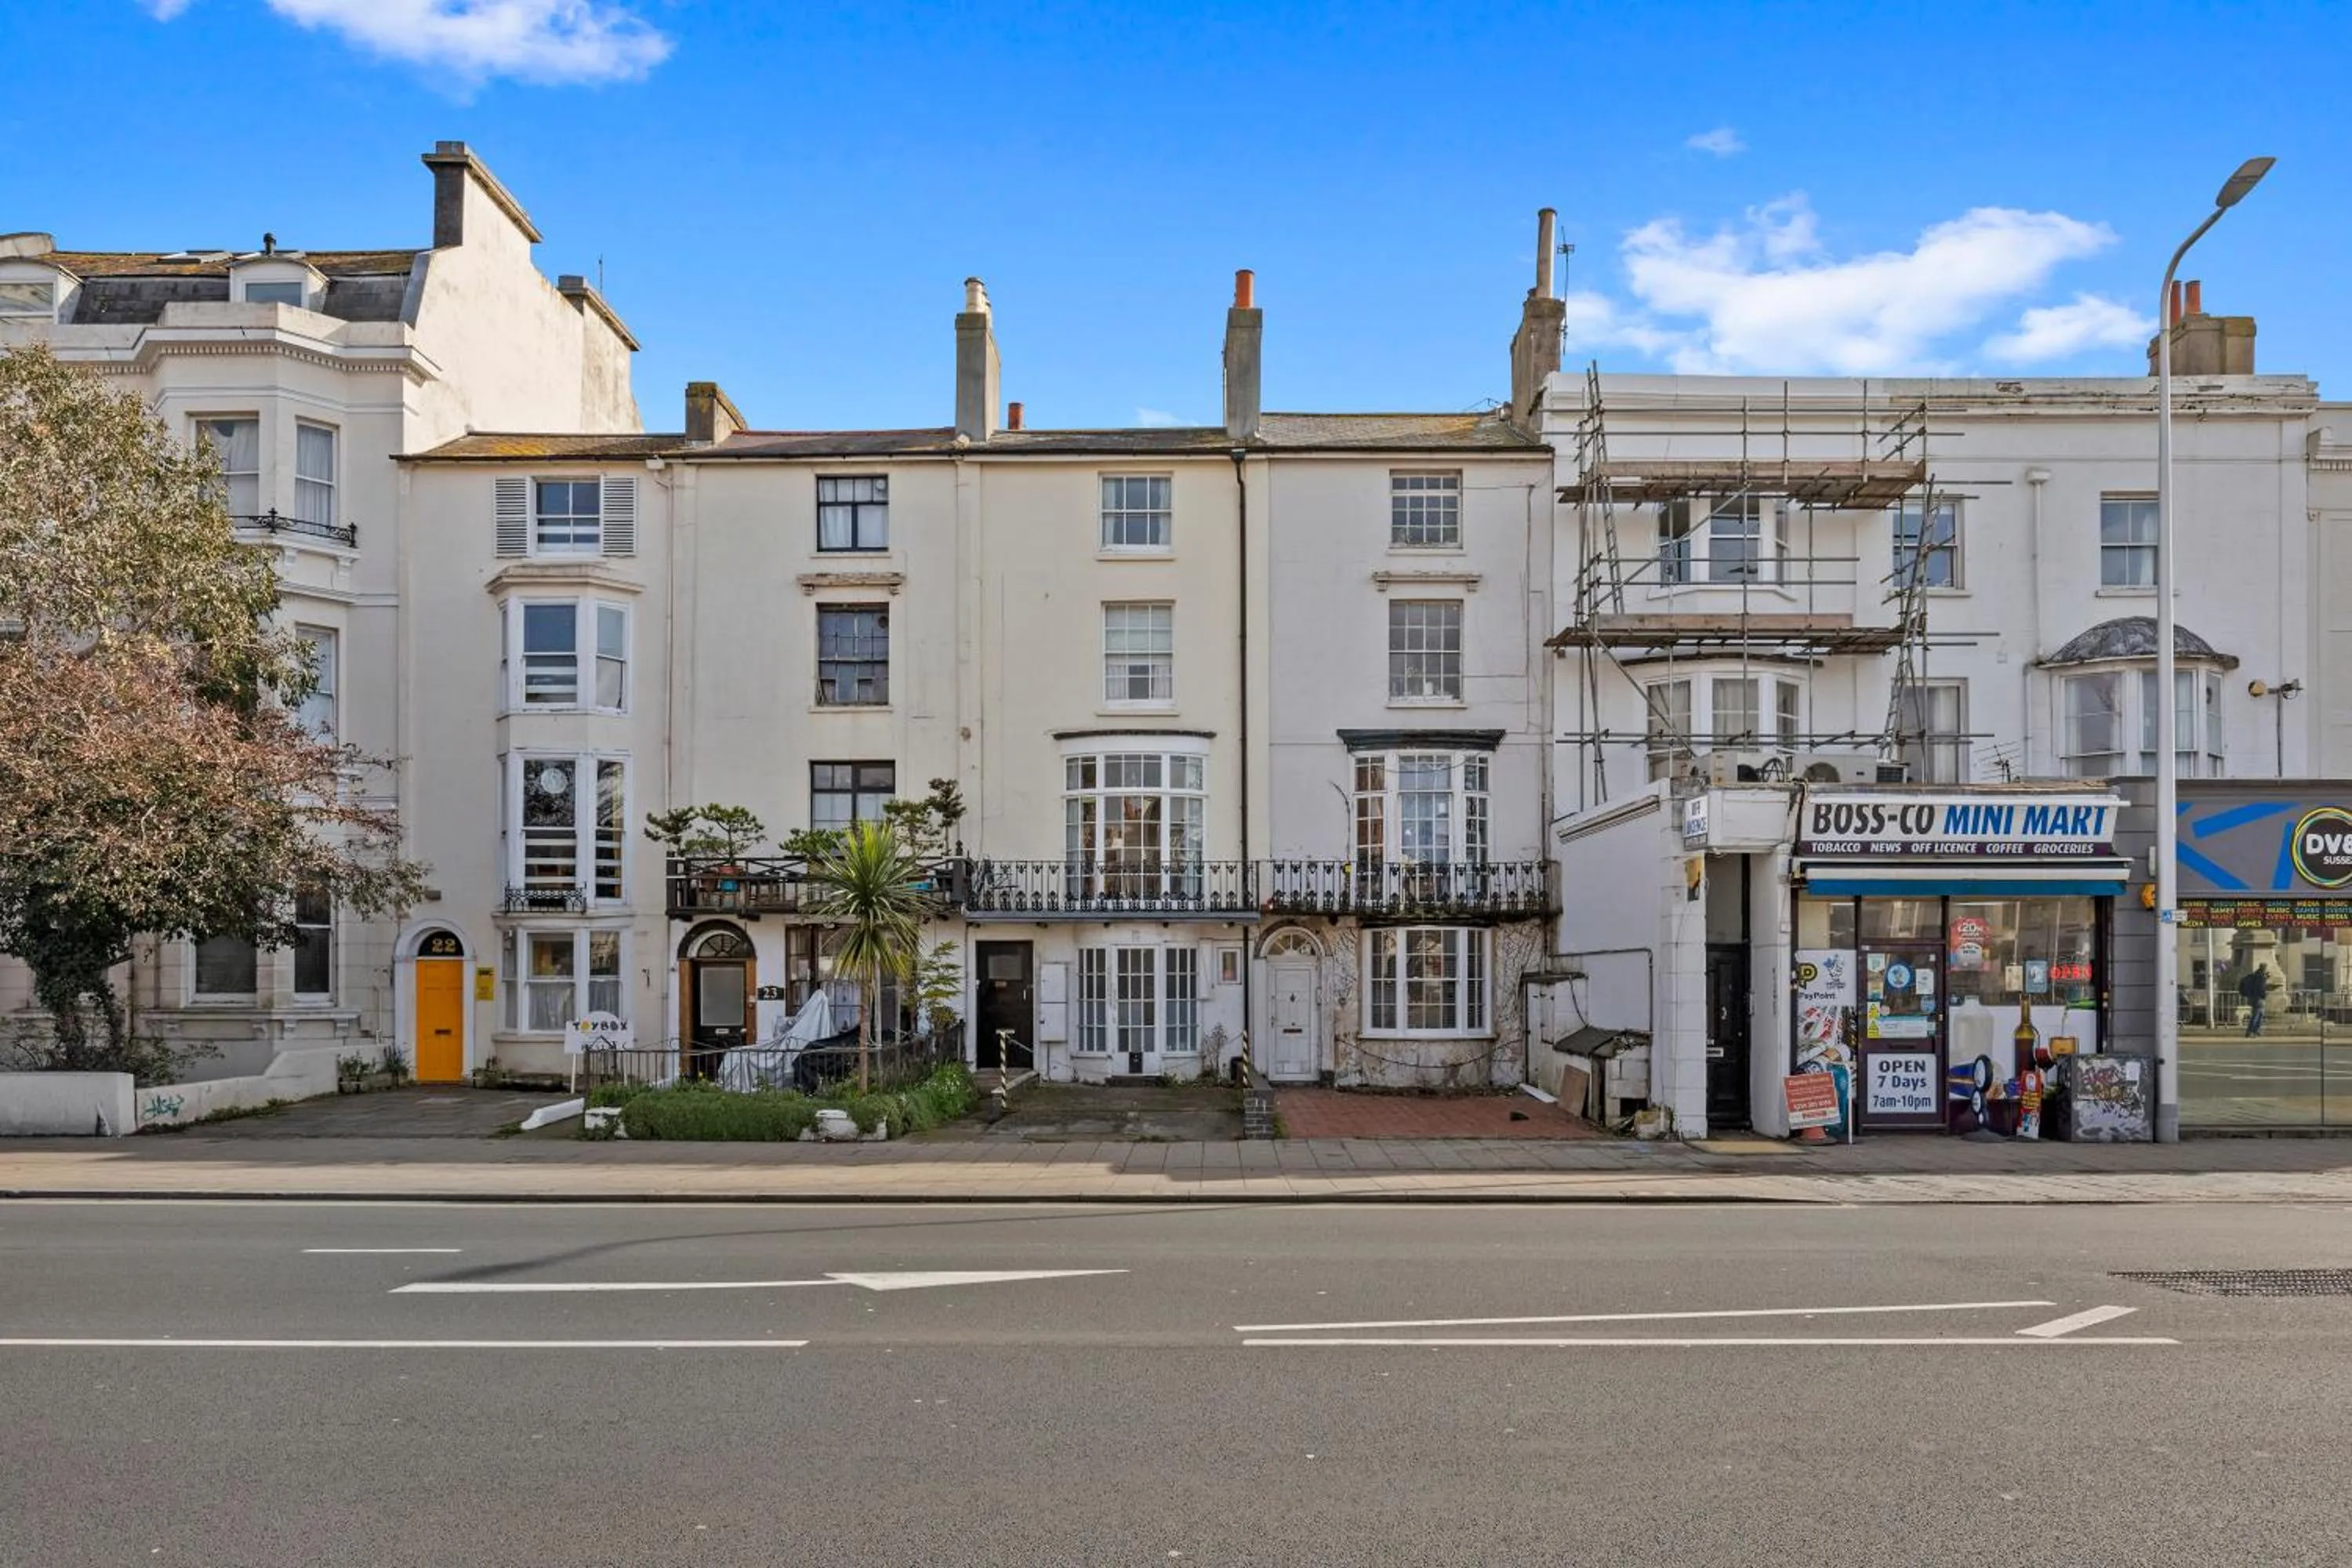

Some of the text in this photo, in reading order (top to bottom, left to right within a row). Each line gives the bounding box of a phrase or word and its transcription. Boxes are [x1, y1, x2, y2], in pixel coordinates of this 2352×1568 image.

[1813, 804, 2108, 836] BOSS-CO MINI MART
[1812, 842, 2095, 855] TOBACCO NEWS OFF LICENCE COFFEE GROCERIES
[2306, 833, 2352, 855] DV8
[432, 938, 456, 953] 22
[764, 988, 778, 999] 23
[1879, 1061, 1926, 1073] OPEN
[1878, 1076, 1926, 1091] 7 Days
[1873, 1095, 1931, 1110] 7am-10pm
